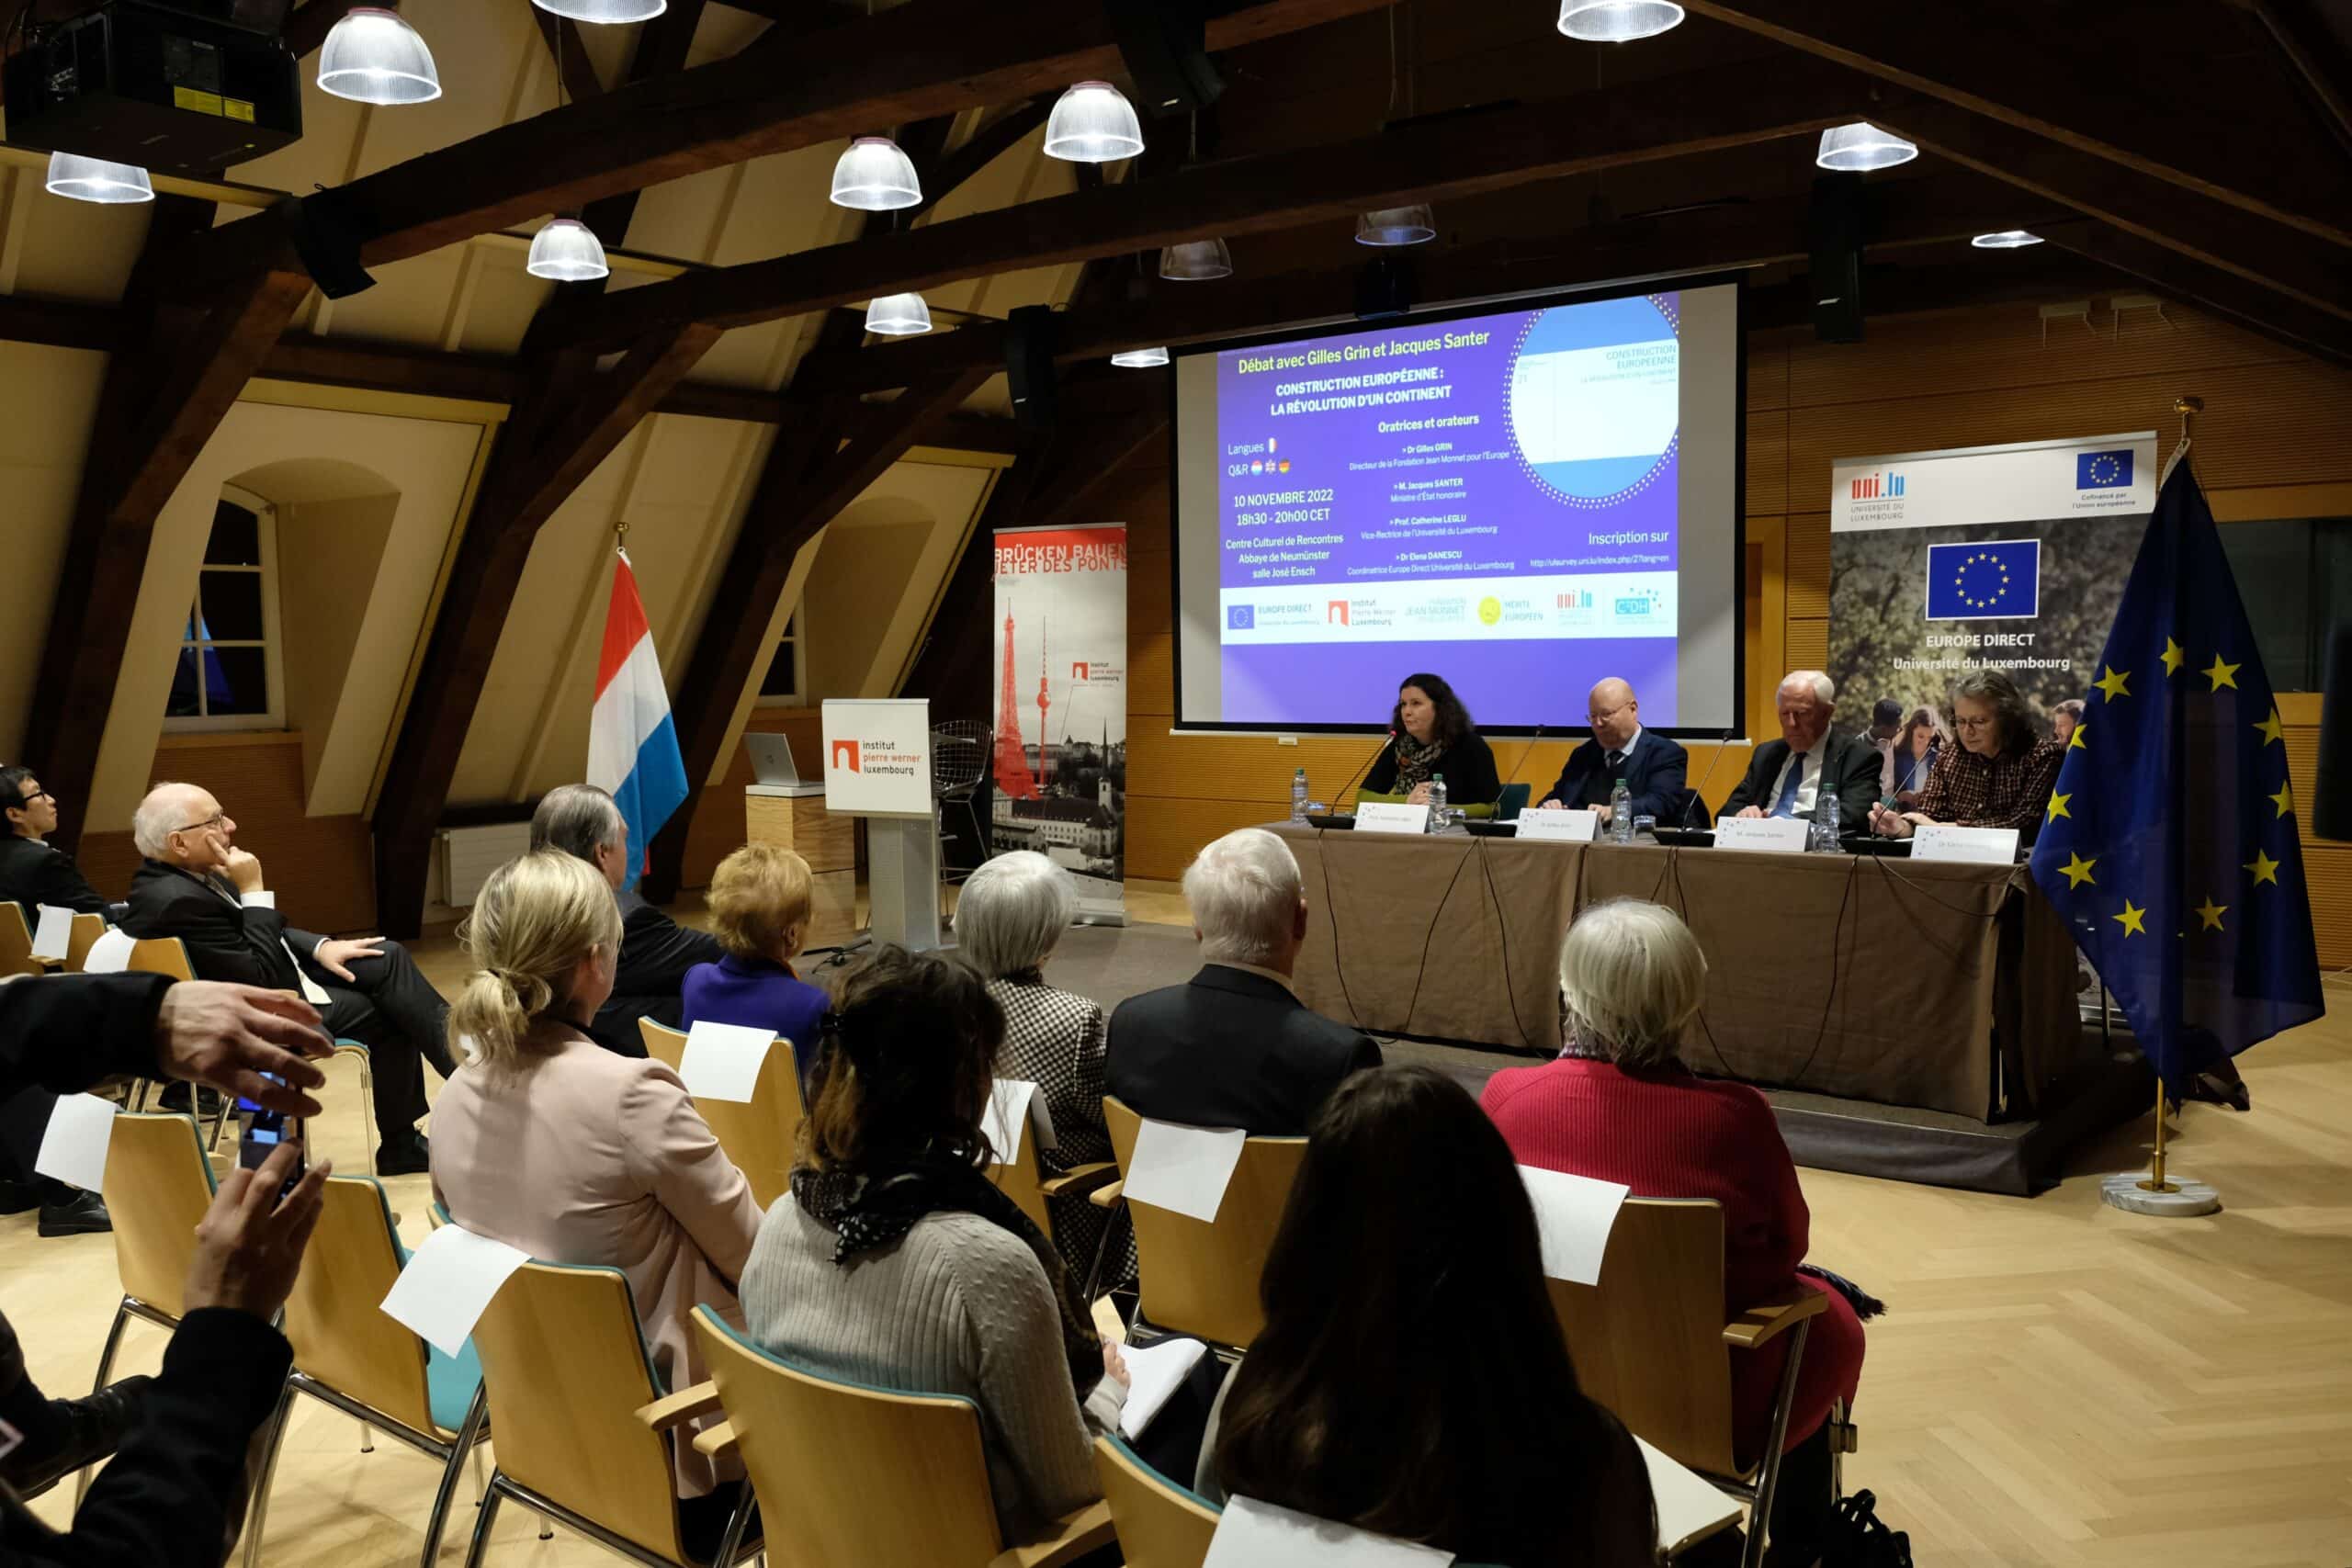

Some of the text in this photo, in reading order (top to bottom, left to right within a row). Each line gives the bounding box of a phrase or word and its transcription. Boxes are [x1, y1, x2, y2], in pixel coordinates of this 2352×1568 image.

[1238, 331, 1489, 374] Débat avec Gilles Grin et Jacques Santer
[1606, 344, 1677, 360] CONSTRUCTION
[1275, 374, 1362, 397] CONSTRUCTION
[1363, 367, 1438, 388] EUROPÉENNE
[1271, 403, 1285, 415] LA
[1285, 395, 1356, 414] RÉVOLUTION
[1385, 385, 1452, 404] CONTINENT
[1378, 414, 1479, 434] Oratrices et orateurs
[1227, 443, 1264, 456] Langues
[1416, 445, 1433, 453] Gilles
[1435, 442, 1453, 452] GRIN
[1350, 461, 1377, 471] Directeur
[1378, 460, 1386, 468] de
[1387, 459, 1393, 468] la
[1394, 457, 1424, 468] Fondation
[1441, 455, 1465, 464] Monnet
[1466, 454, 1481, 464] pour
[1228, 463, 1249, 477] Q&R
[1398, 478, 1464, 491] M. Jacques SANTER
[1852, 472, 1904, 500] uni.lu
[1234, 489, 1333, 508] 10 NOVEMBRE 2022
[1436, 491, 1467, 500] honoraire
[1850, 502, 1904, 513] UNIVERSITÉ DU
[2097, 501, 2135, 509] européenne
[1237, 513, 1267, 526] 18h30
[1275, 511, 1307, 524] 20h00
[1309, 508, 1330, 521] CET
[1411, 516, 1442, 525] Catherine
[1443, 514, 1467, 524] LEGLU
[1850, 513, 1904, 522] LUXEMBOURG
[1403, 529, 1410, 537] de
[1447, 527, 1455, 536] du
[1456, 525, 1498, 536] Luxembourg
[1227, 534, 1344, 549] Centre Culturel de Rencontres
[1589, 531, 1668, 546] Inscription sur
[995, 543, 1126, 561] BRÜCKEN BAUEN
[1238, 550, 1329, 565] Abbaye de Neumünster
[1400, 550, 1463, 561] Dr Elena DANESCU
[1044, 559, 1072, 573] DES
[1253, 566, 1316, 579] salle José Ensch
[1388, 565, 1410, 575] Europe
[1411, 564, 1430, 573] Direct
[1464, 562, 1472, 570] du
[1474, 561, 1514, 570] Luxembourg
[1258, 604, 1312, 615] EUROPE DIRECT
[1926, 634, 2035, 648] EUROPE DIRECT
[1893, 656, 2070, 671] Université du Luxembourg
[863, 740, 895, 750] institut
[864, 753, 921, 763] pierre werner
[864, 764, 914, 776] luxembourg
